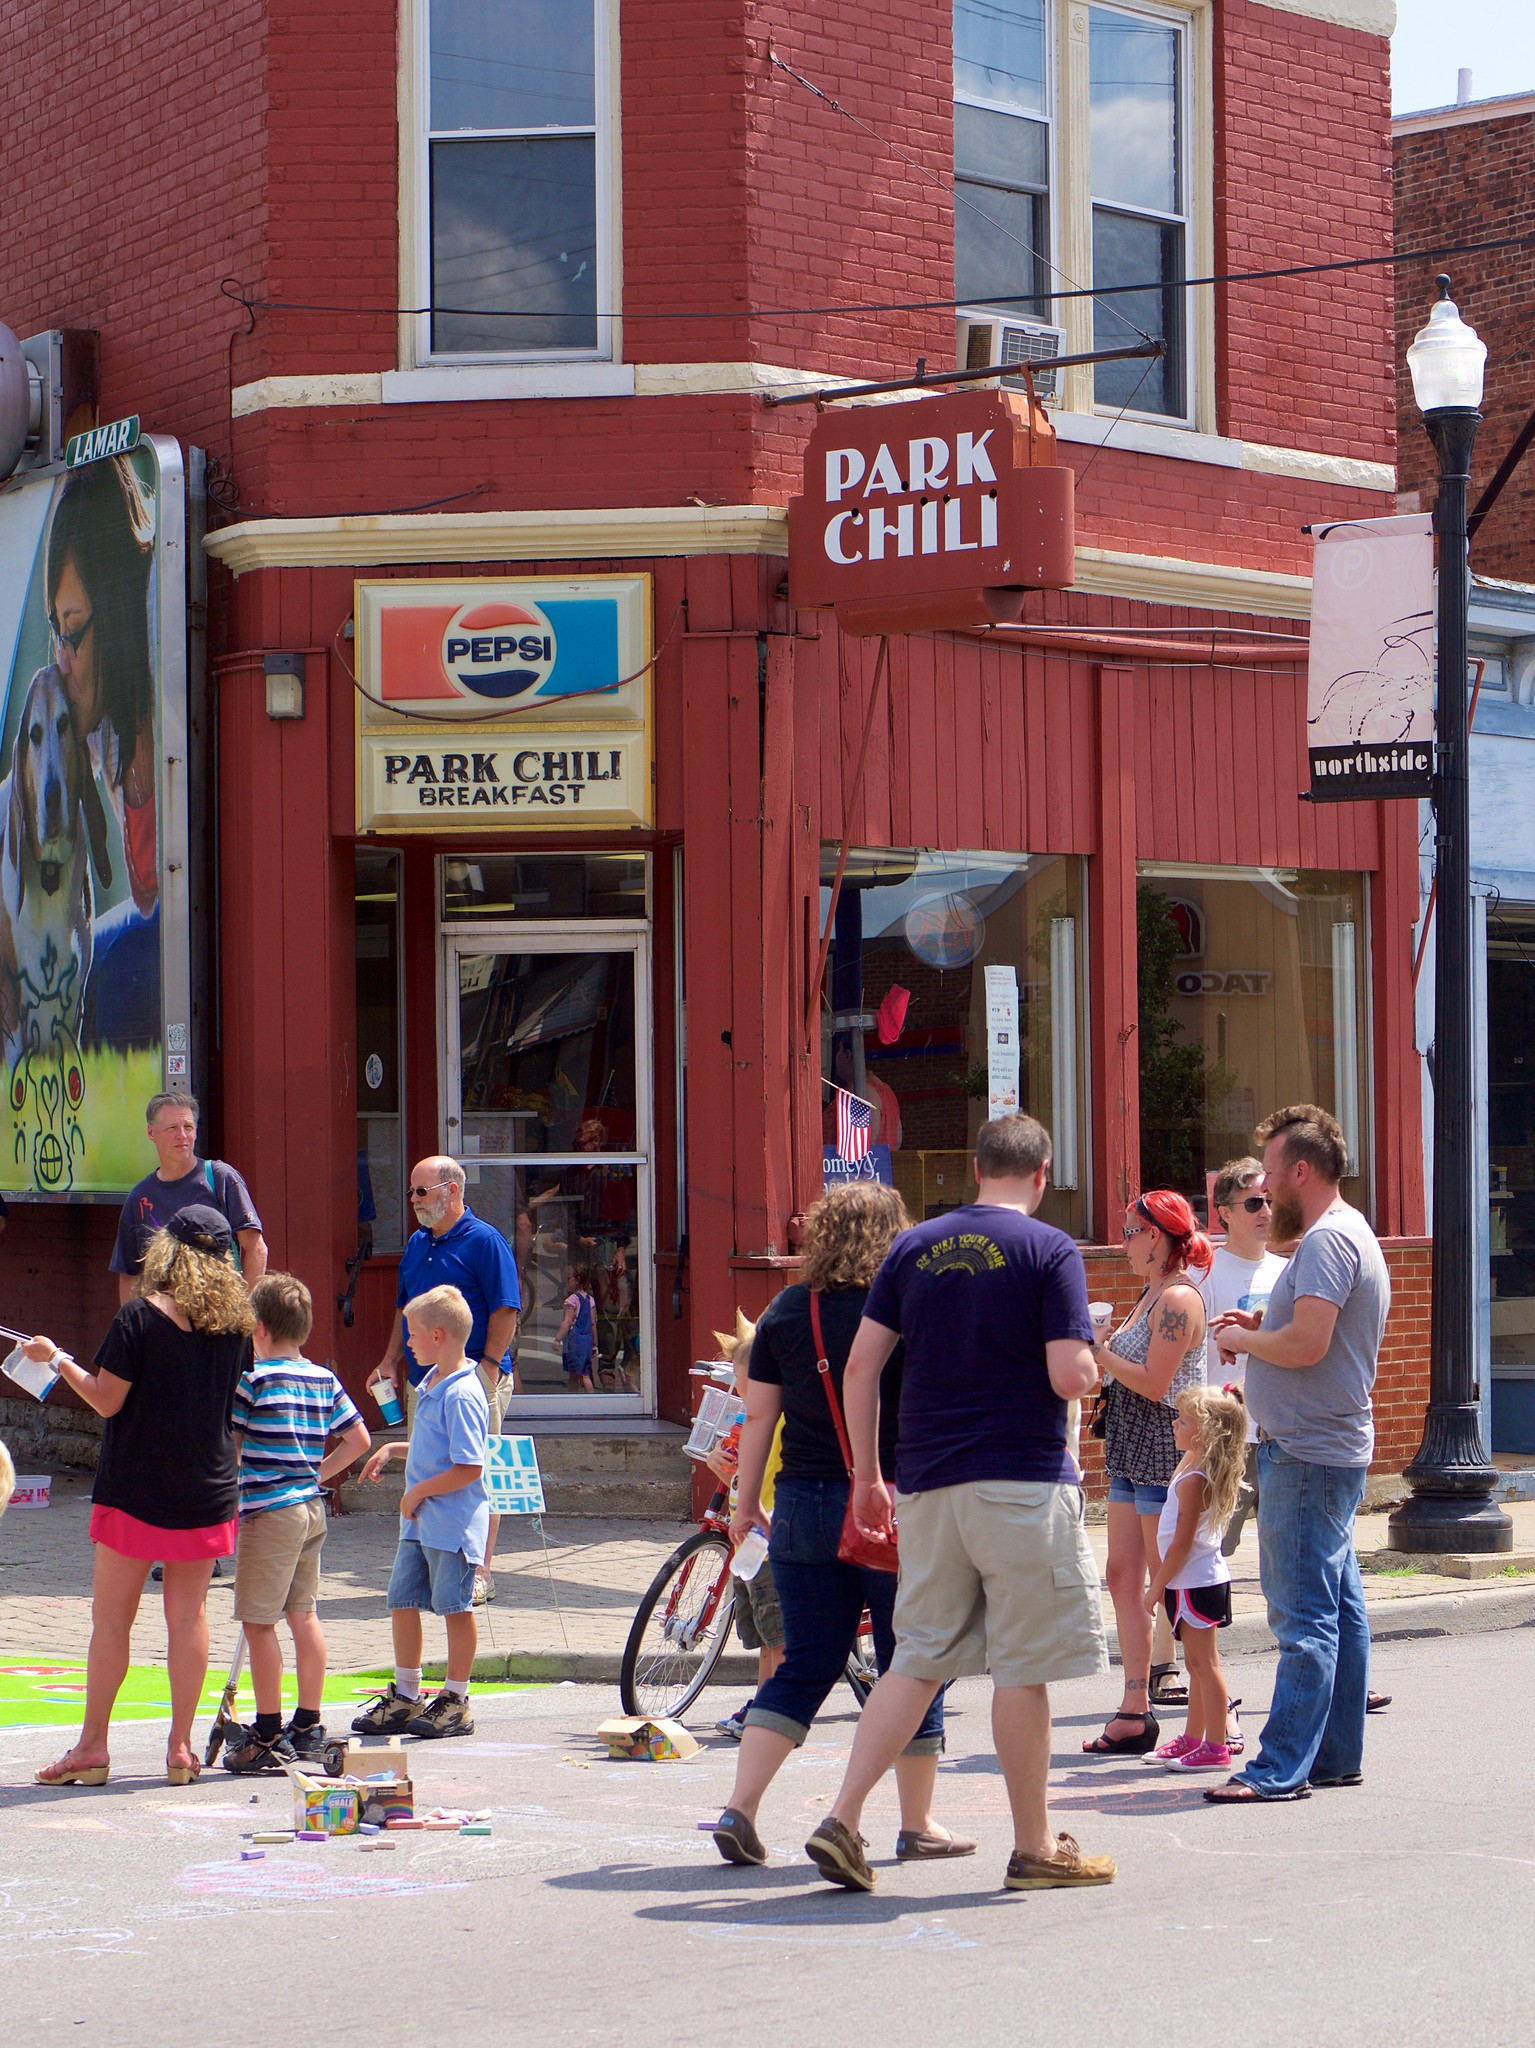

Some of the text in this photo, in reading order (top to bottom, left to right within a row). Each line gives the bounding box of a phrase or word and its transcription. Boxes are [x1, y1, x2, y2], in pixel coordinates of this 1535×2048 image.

[73, 420, 131, 465] LAMAR
[825, 428, 998, 503] PARK
[824, 494, 998, 565] CHILI
[447, 635, 552, 664] PEPSI
[384, 751, 623, 785] PARK CHILI
[1314, 749, 1429, 777] northside
[418, 783, 586, 806] BREAKFAST
[915, 1253, 928, 1268] OF
[931, 1236, 955, 1254] DIRT
[958, 1233, 990, 1247] YOU'RE
[987, 1242, 1007, 1269] MADE
[486, 1436, 532, 1467] RT
[489, 1495, 545, 1512] REETS
[330, 1797, 355, 1808] CHALK
